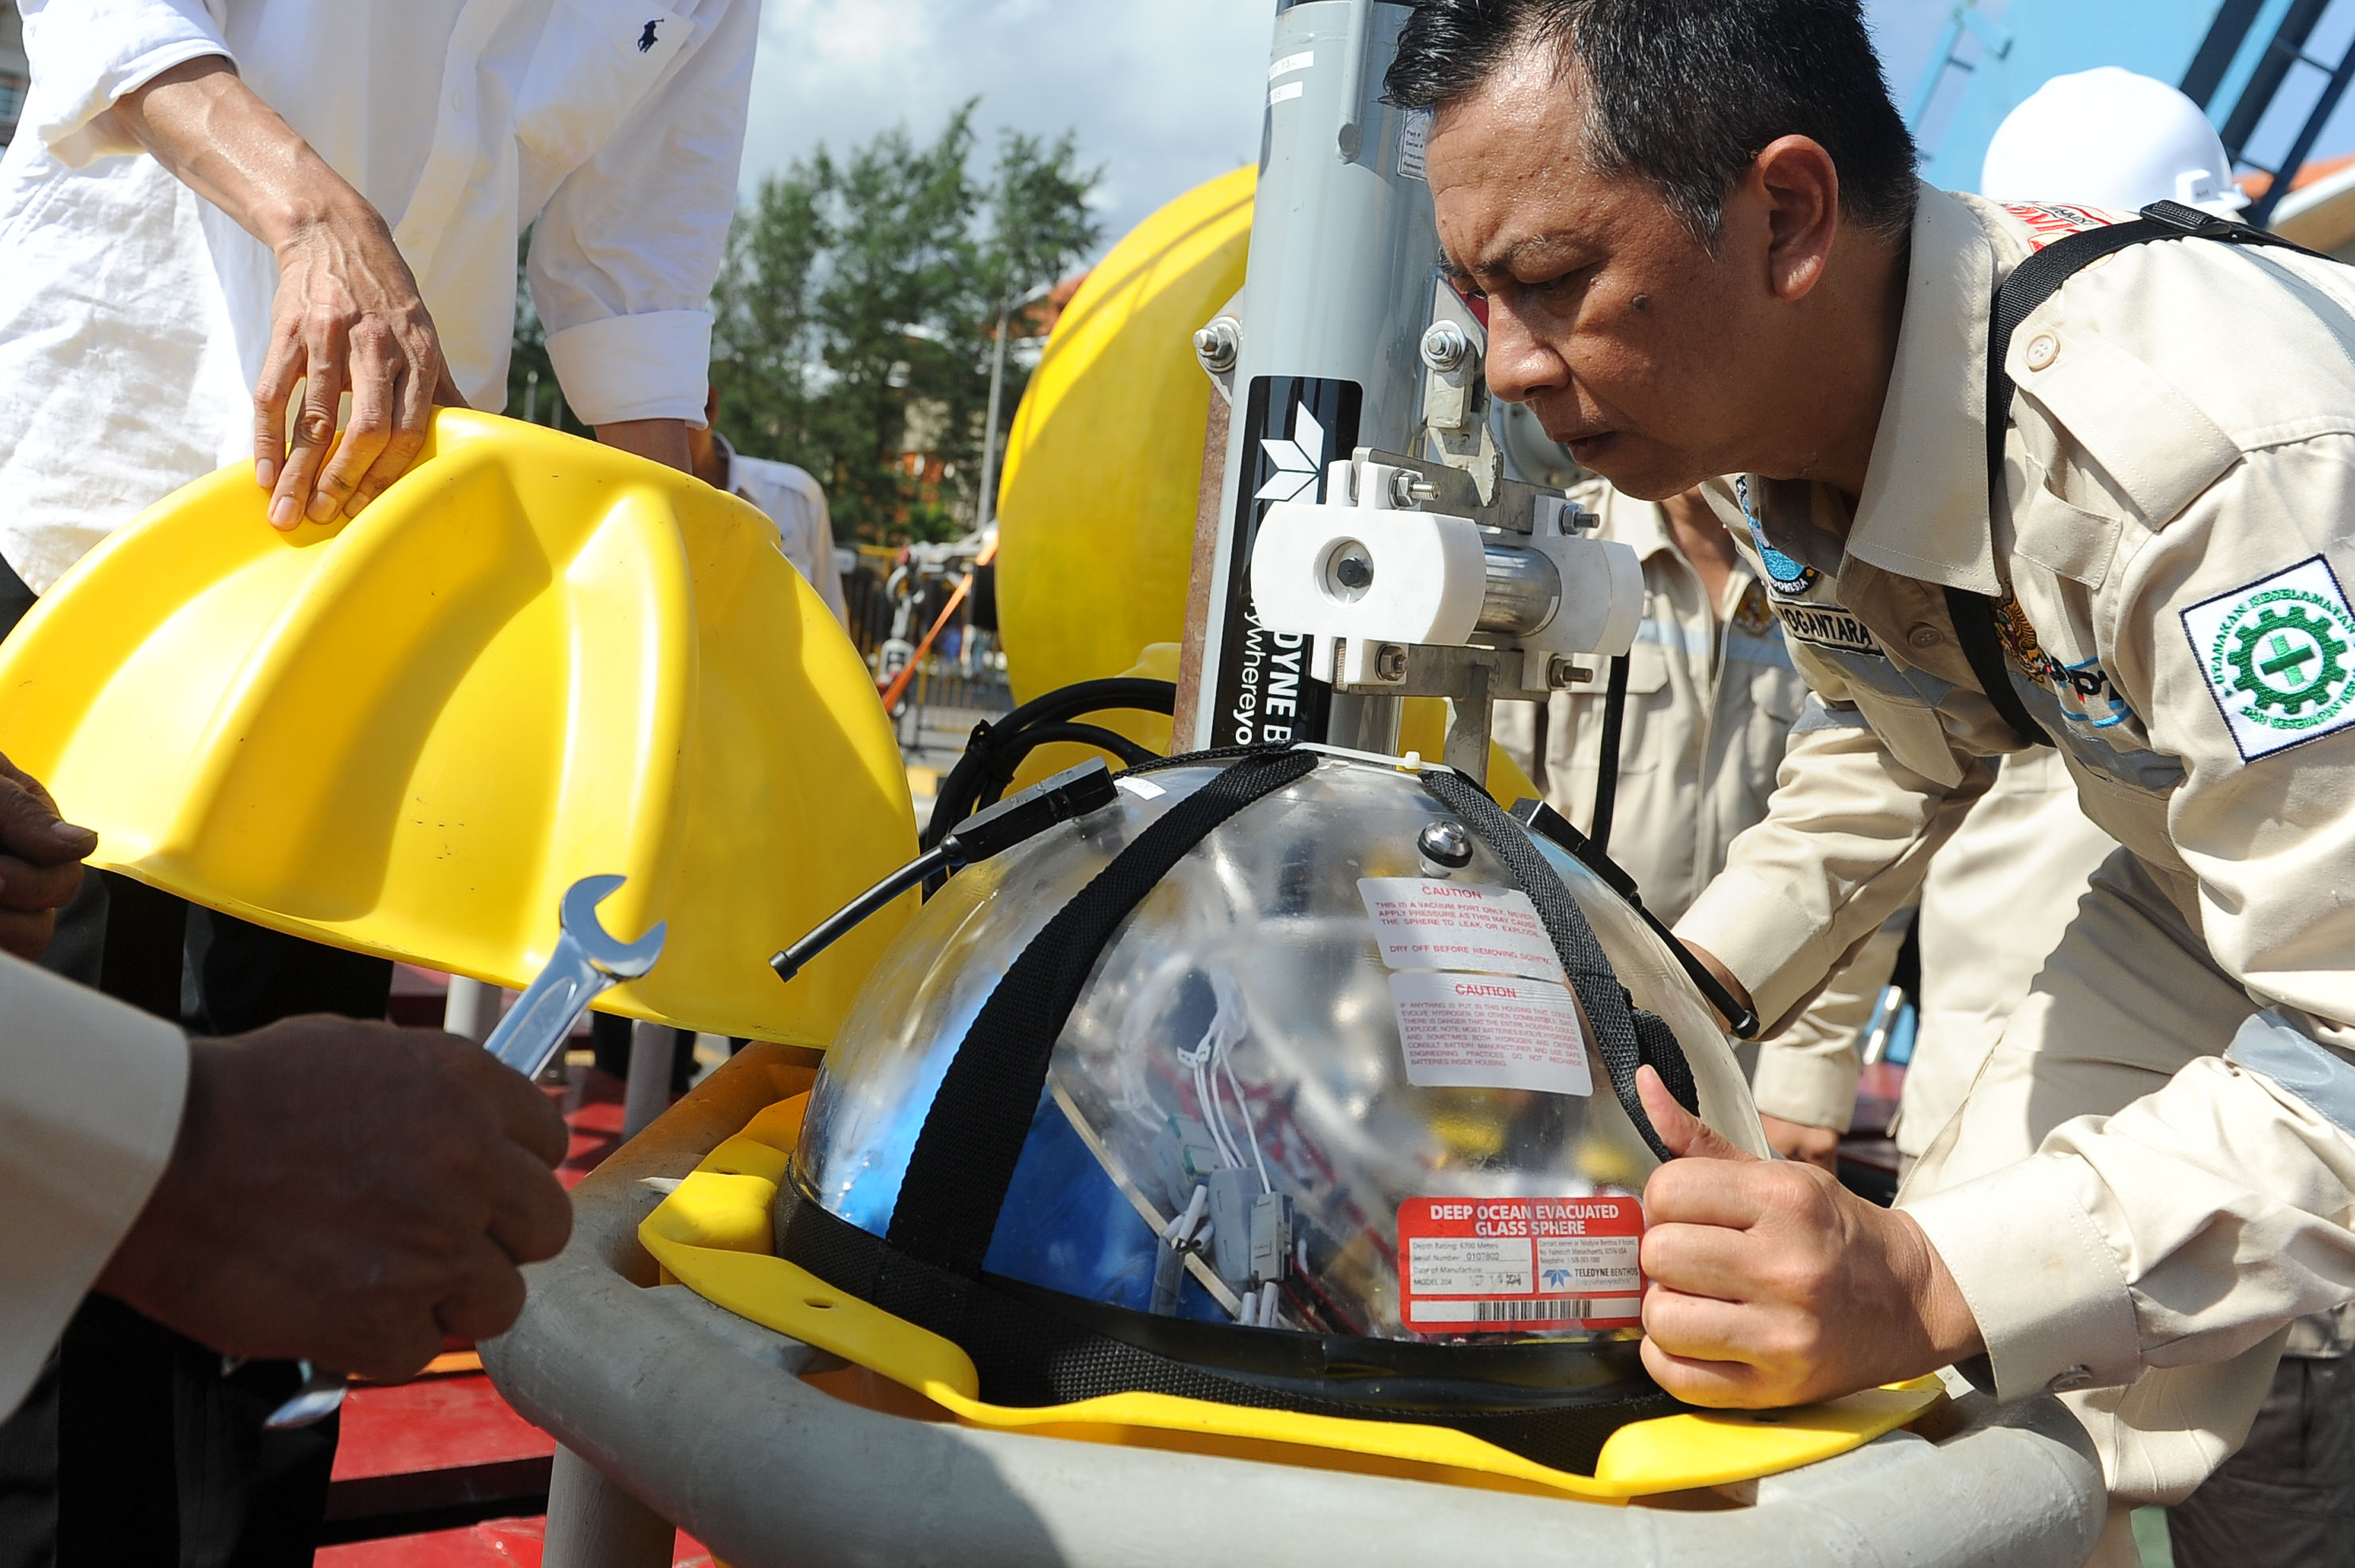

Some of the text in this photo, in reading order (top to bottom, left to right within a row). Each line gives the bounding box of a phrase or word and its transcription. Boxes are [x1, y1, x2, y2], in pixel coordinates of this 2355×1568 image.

[1422, 885, 1483, 900] CAUTION
[1457, 904, 1480, 913] PORT
[1507, 910, 1535, 921] NEVER
[1492, 915, 1509, 924] MAY
[1511, 919, 1538, 929] CAUSE
[1433, 944, 1469, 953] BEFORE
[1473, 948, 1518, 959] REMOVING
[1455, 983, 1517, 998] CAUTION
[1430, 1204, 1620, 1220] DEEP OCEAN EVACUATED
[1475, 1220, 1586, 1236] GLASS SPHERE
[1574, 1267, 1639, 1277] TELEDYNE BENTHOS
